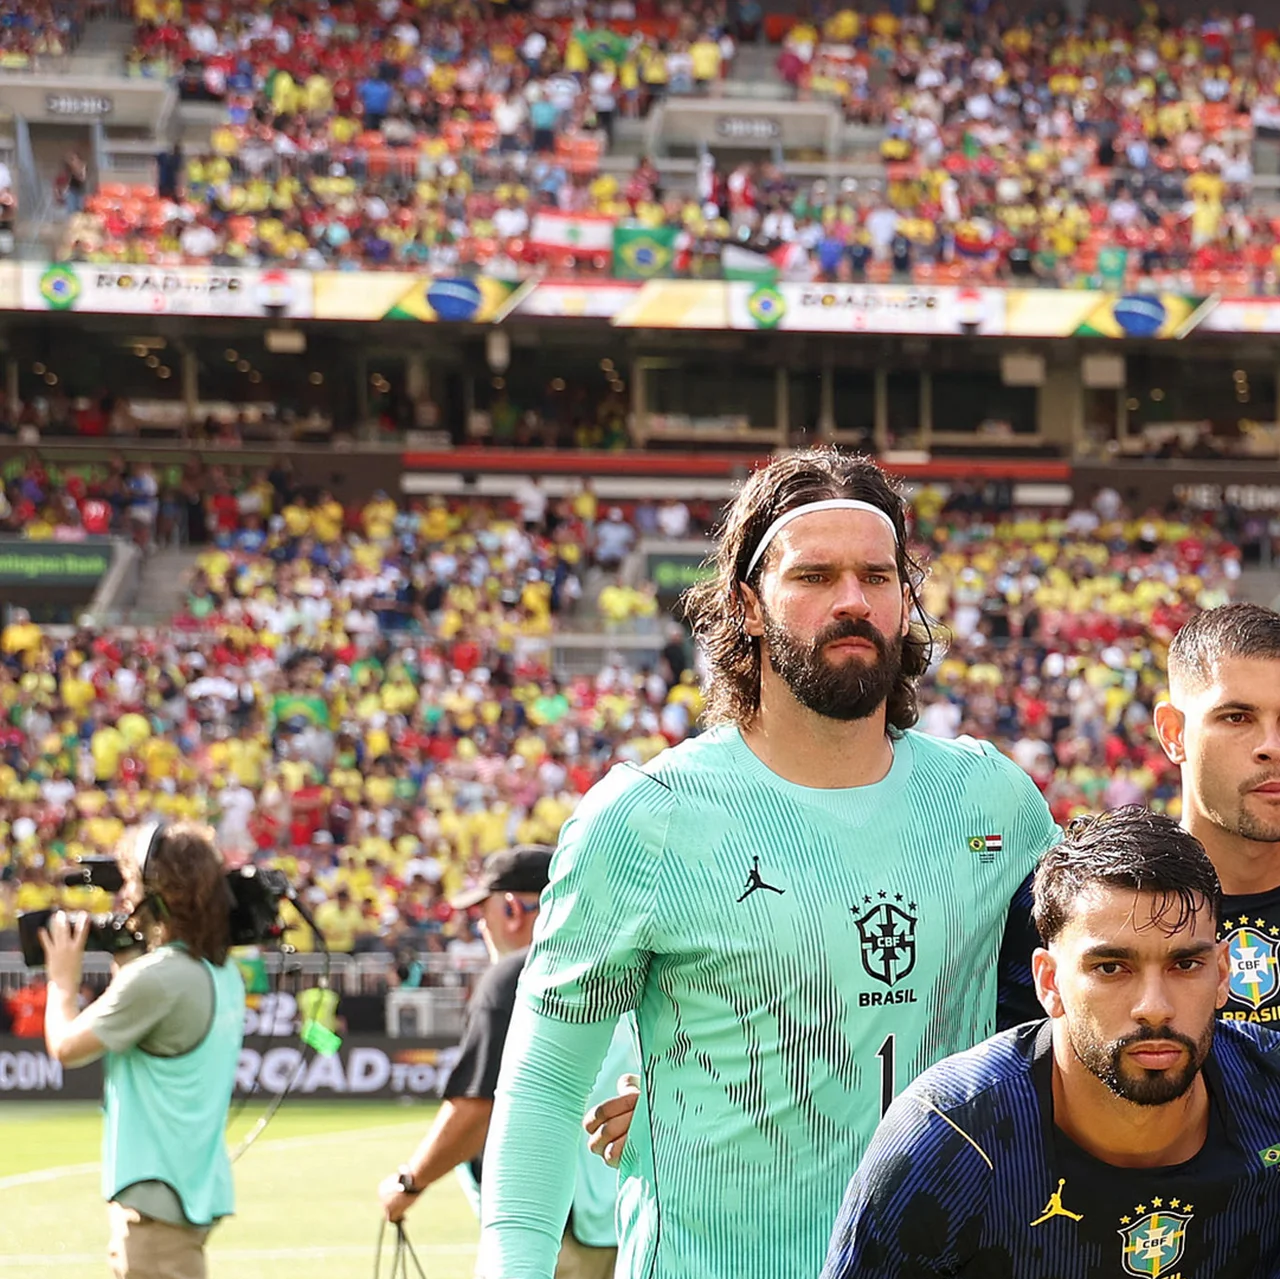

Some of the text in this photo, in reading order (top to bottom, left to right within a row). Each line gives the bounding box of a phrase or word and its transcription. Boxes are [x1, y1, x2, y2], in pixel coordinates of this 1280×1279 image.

[877, 936, 901, 948] CBF
[1237, 960, 1261, 971] CBF
[859, 989, 918, 1006] BRASIL
[875, 1033, 896, 1120] 1
[1141, 1238, 1168, 1250] CBF
